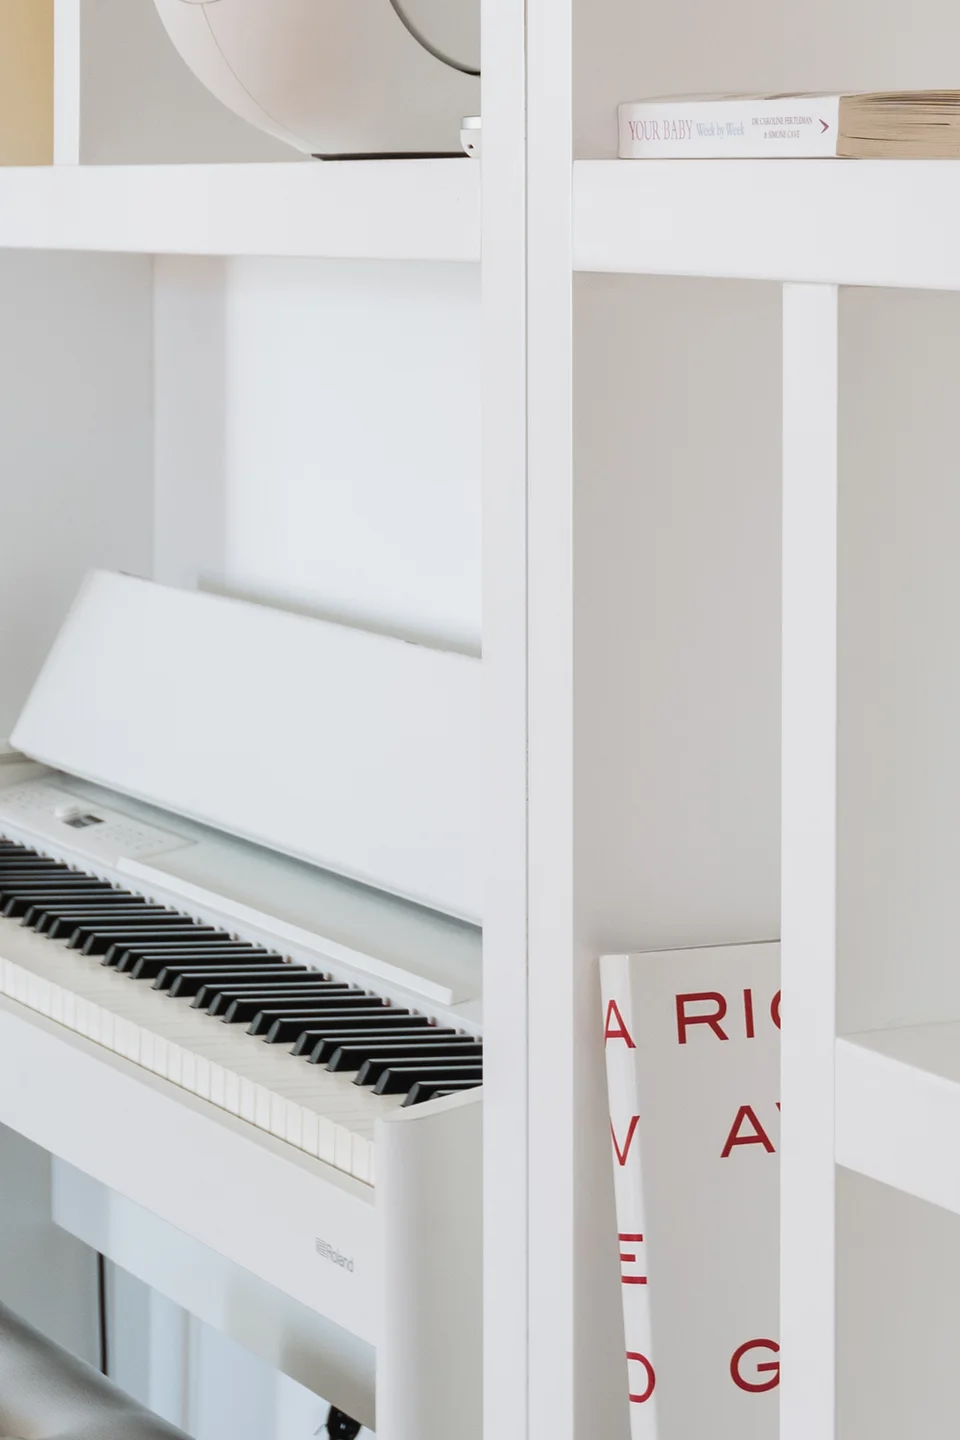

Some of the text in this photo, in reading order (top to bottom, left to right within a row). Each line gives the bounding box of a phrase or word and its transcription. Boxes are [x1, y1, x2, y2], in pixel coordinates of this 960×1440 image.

[760, 117, 783, 126] CAROLINE
[628, 120, 745, 141] YOUR BABY Week by Week
[768, 130, 786, 139] SIMONE
